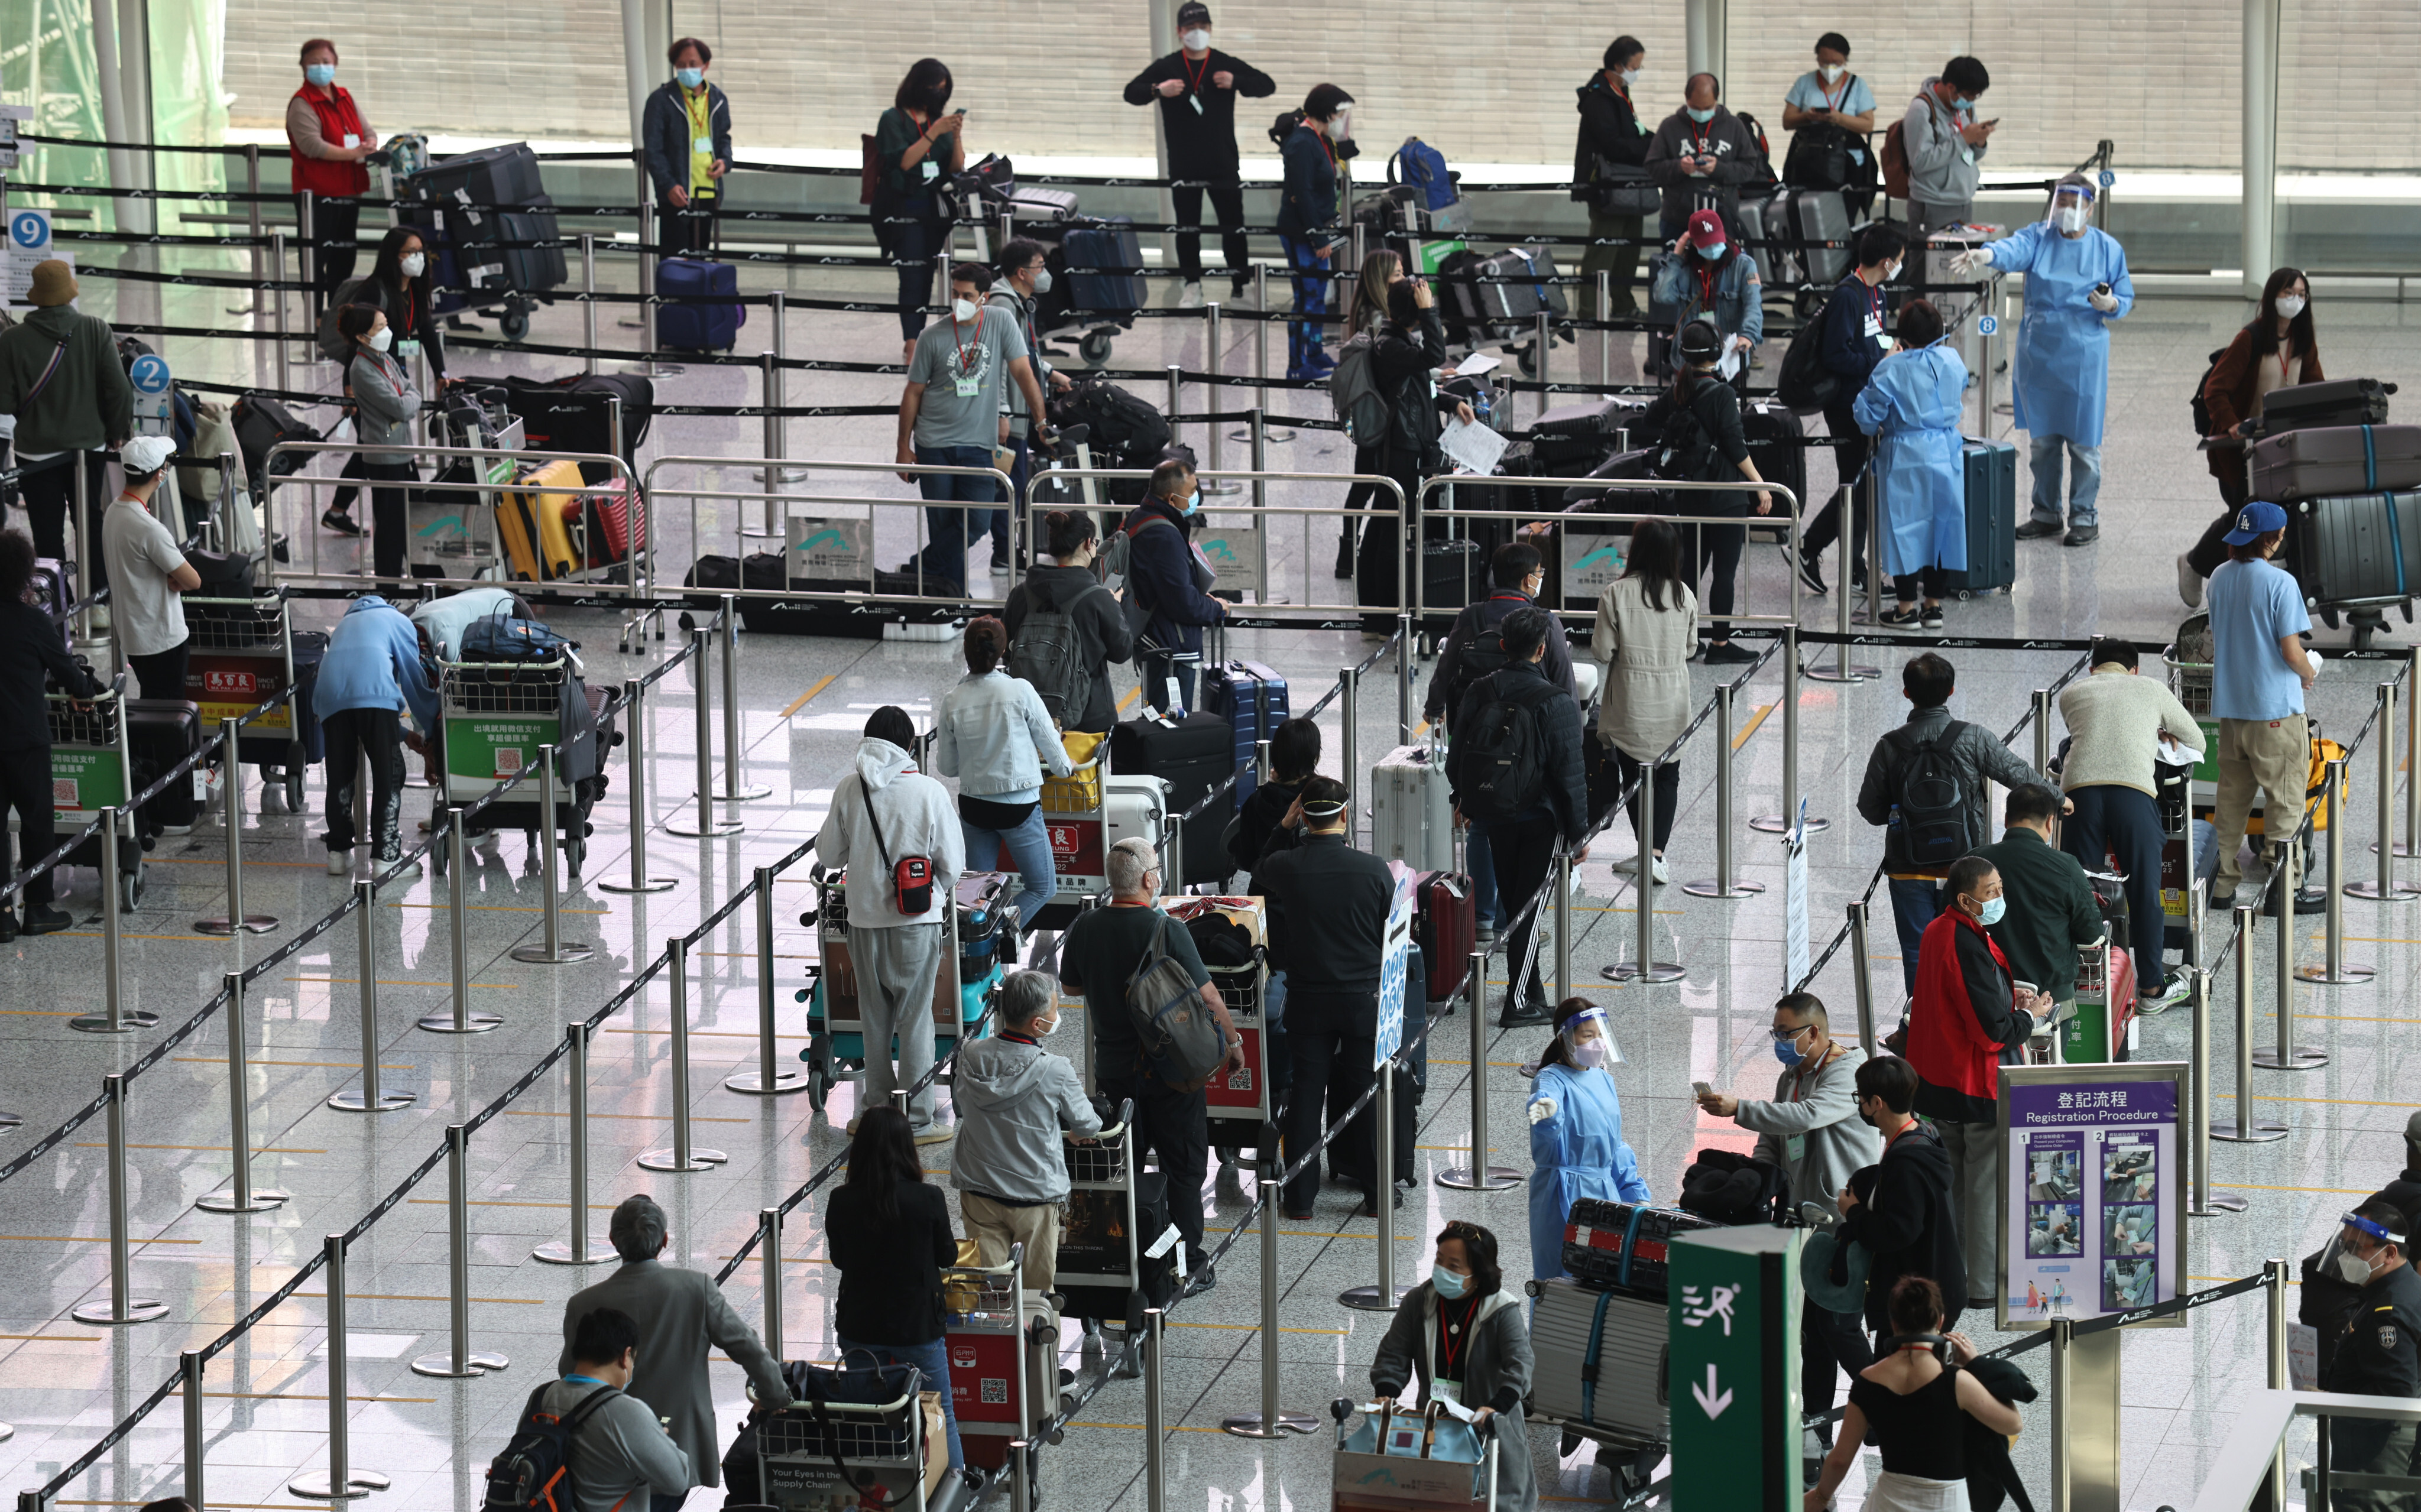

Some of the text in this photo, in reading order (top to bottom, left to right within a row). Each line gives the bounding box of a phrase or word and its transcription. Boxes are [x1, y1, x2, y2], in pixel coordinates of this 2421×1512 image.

[21, 219, 40, 244] 9
[142, 361, 160, 387] 2
[2241, 514, 2250, 530] LA
[211, 673, 249, 686] 馬百良
[474, 724, 541, 733] 出境就用微信支付
[51, 754, 96, 764] 用微信支付
[2071, 1020, 2081, 1029] 付
[2057, 1091, 2127, 1108] 登記流程
[2027, 1109, 2159, 1124] Registration Procedure
[2096, 1133, 2102, 1141] 2
[795, 1469, 815, 1479] Eyes
[773, 1479, 803, 1489] Supply
